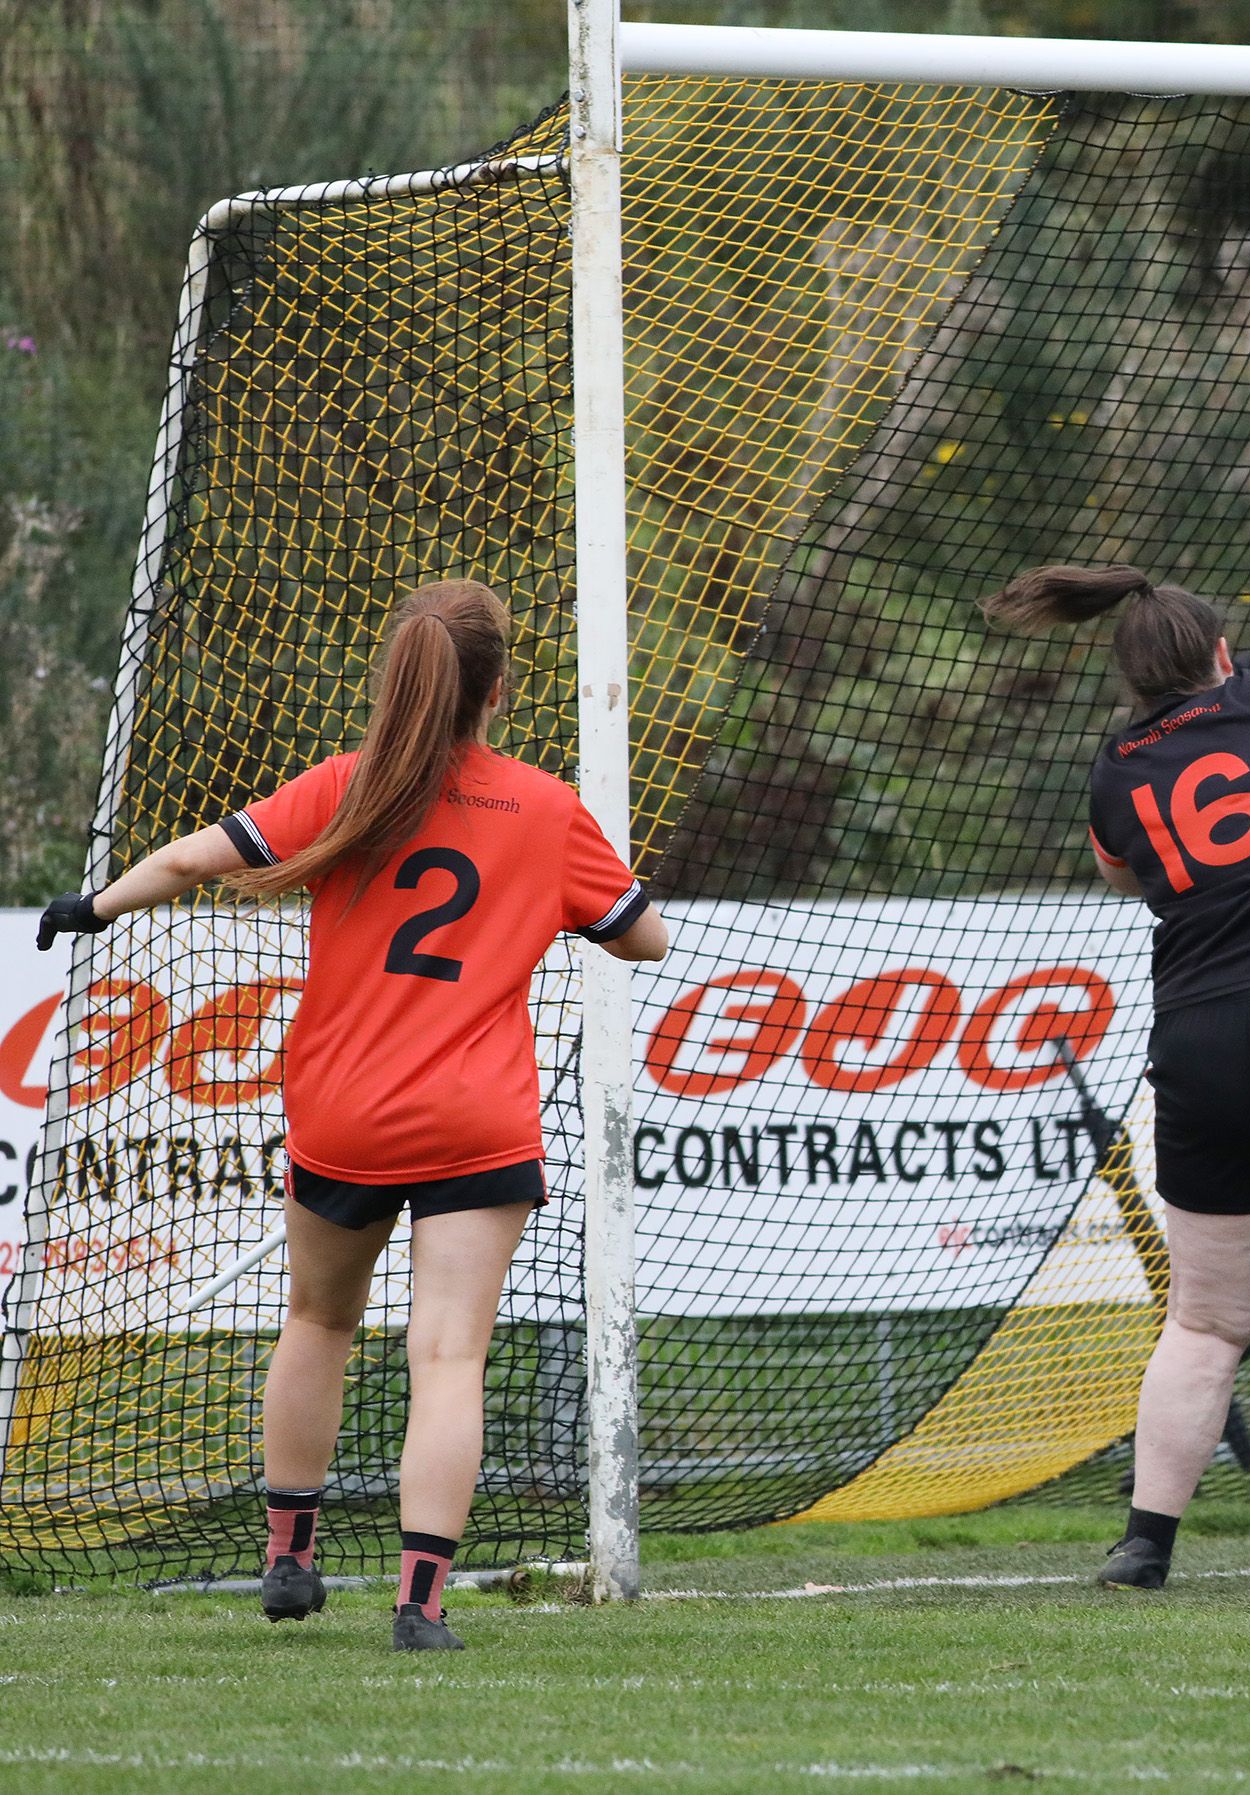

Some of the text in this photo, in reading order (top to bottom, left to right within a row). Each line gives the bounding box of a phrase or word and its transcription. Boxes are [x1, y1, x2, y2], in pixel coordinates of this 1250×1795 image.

[384, 846, 480, 983] 2
[633, 1115, 1112, 1190] CONTRACTS LT
